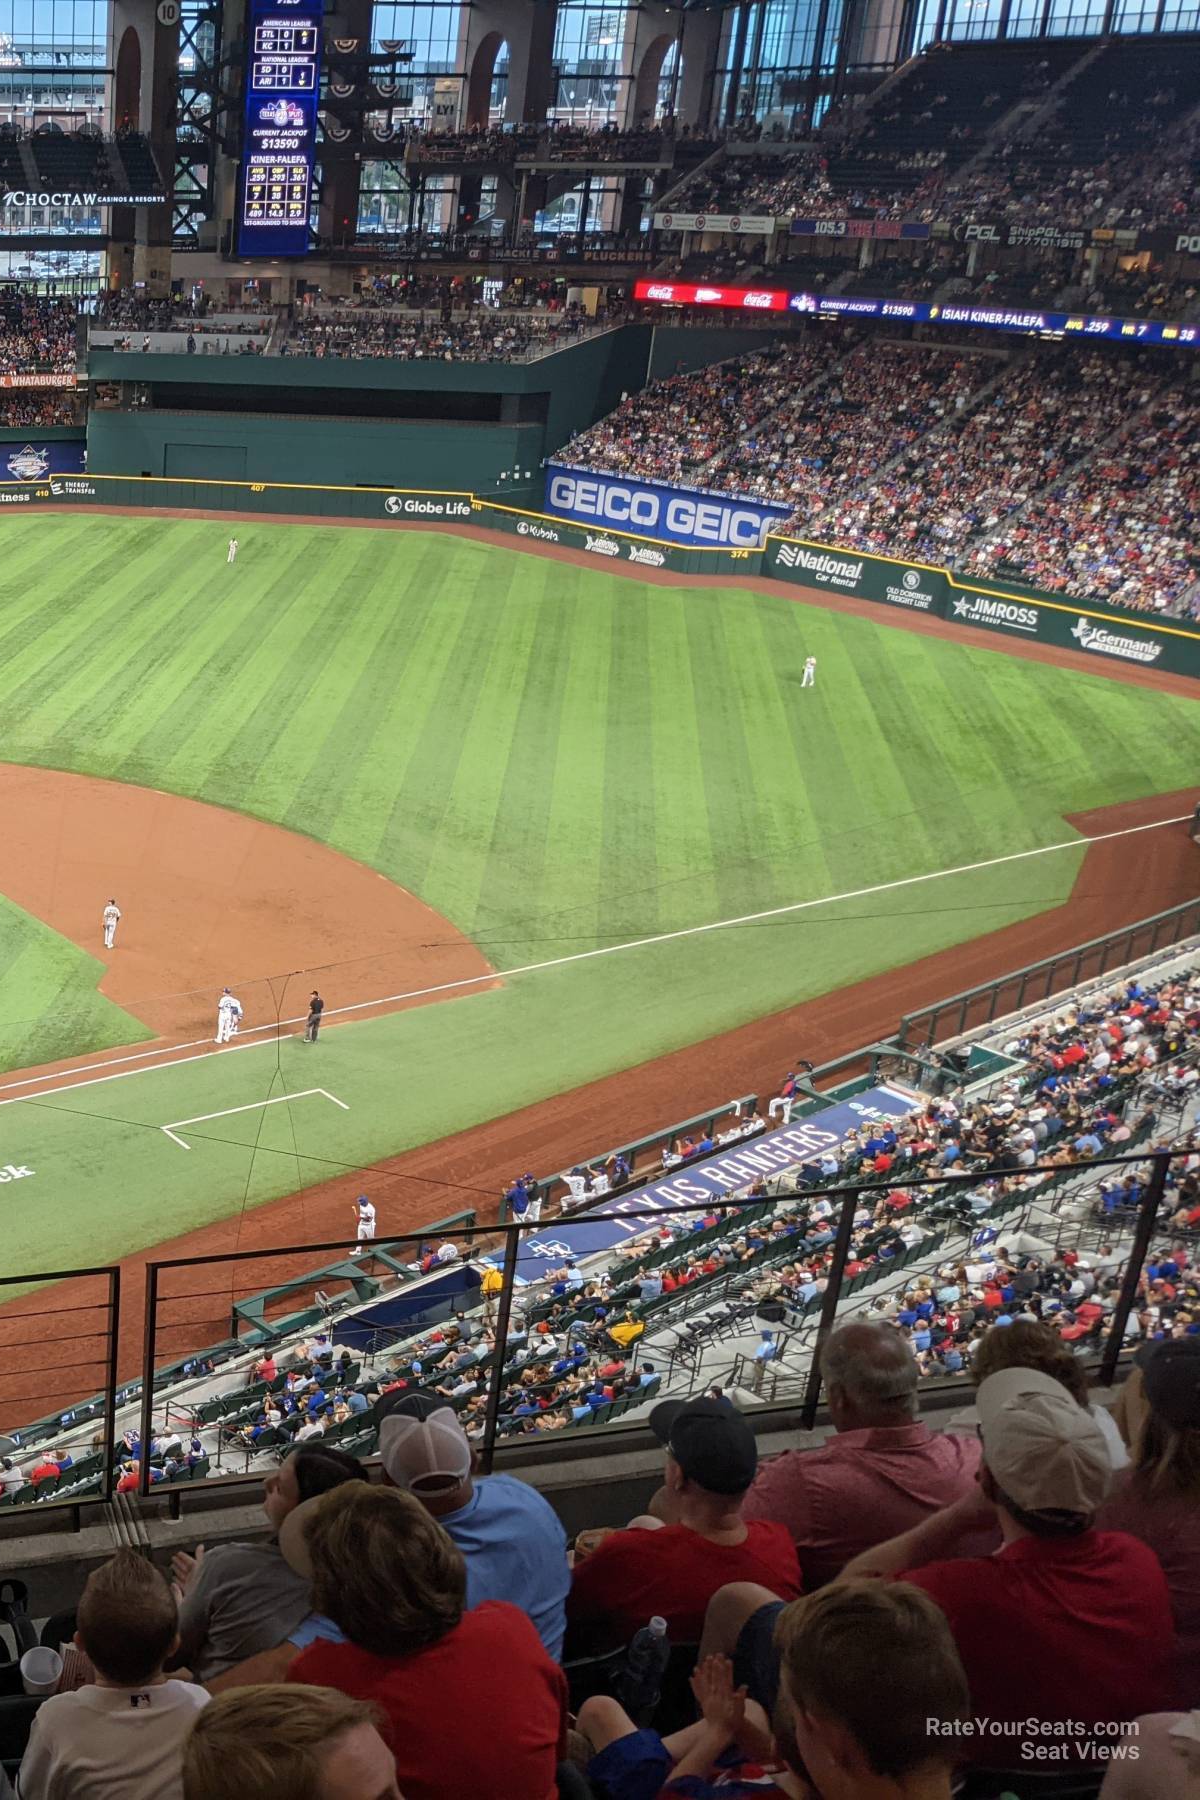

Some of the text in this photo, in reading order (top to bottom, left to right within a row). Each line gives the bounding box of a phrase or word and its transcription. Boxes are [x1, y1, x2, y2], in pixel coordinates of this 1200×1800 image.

[162, 5, 175, 19] 10
[261, 139, 298, 149] $13590
[250, 156, 307, 164] KINER-FALEFA
[12, 191, 97, 206] CHOCTAW
[814, 220, 846, 235] 105.3
[965, 225, 1000, 240] PGL
[820, 301, 914, 316] CURRENT JACKPOT $13590
[942, 309, 969, 321] ISIAH
[970, 311, 1043, 328] KINER-FALEFA
[1084, 321, 1109, 332] .259
[1138, 326, 1147, 336] 7
[1180, 329, 1195, 340] 38
[10, 375, 73, 387] WHATABURGER
[35, 489, 49, 497] 410
[65, 487, 96, 495] TRANSFER
[250, 484, 265, 492] 407
[404, 499, 471, 516] Globe Life
[550, 476, 659, 526] GEICO
[529, 525, 560, 542] Kubota
[730, 550, 749, 559] 374
[815, 573, 857, 588] Car Rental
[886, 586, 932, 601] OLD DOMINION
[886, 594, 913, 605] FREIGHT
[1095, 629, 1163, 656] Germania
[699, 1123, 839, 1188] RANGERS
